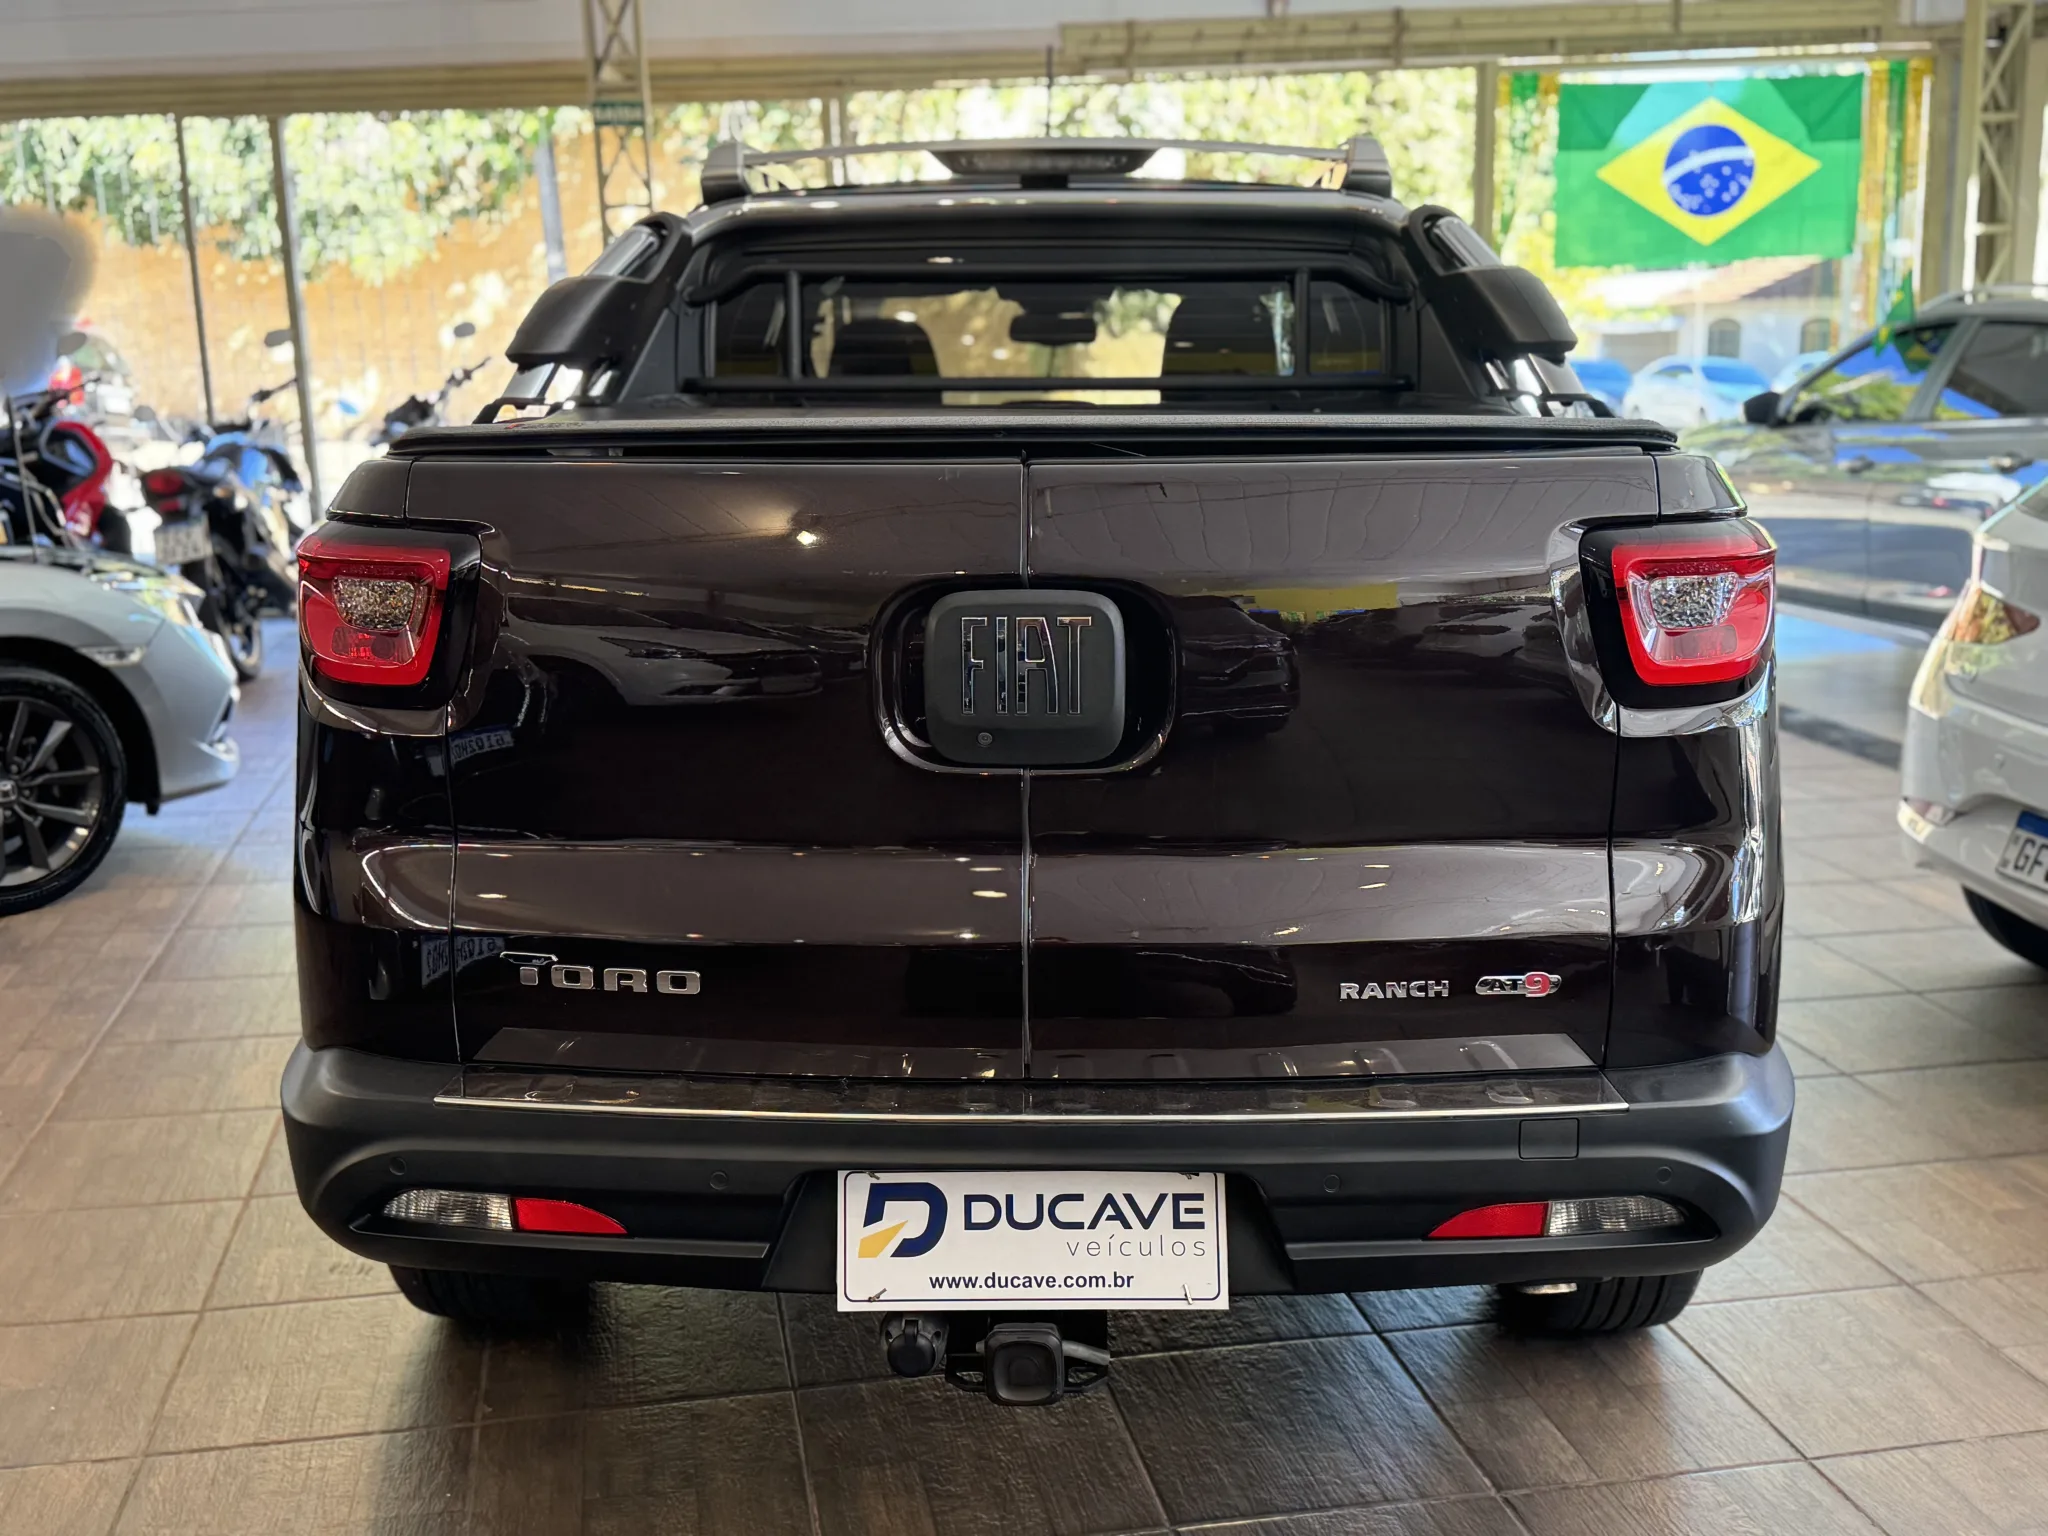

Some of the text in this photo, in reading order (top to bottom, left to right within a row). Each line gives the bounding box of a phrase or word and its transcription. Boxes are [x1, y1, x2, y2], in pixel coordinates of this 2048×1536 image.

[961, 616, 1092, 715] FIAT
[2013, 838, 2048, 883] GF
[499, 951, 701, 995] TORO
[1340, 971, 1553, 1000] RANCH AT9
[963, 1193, 1206, 1231] DUCAVE
[1066, 1234, 1206, 1257] veículos
[928, 1271, 1135, 1289] www.ducave.com.br
